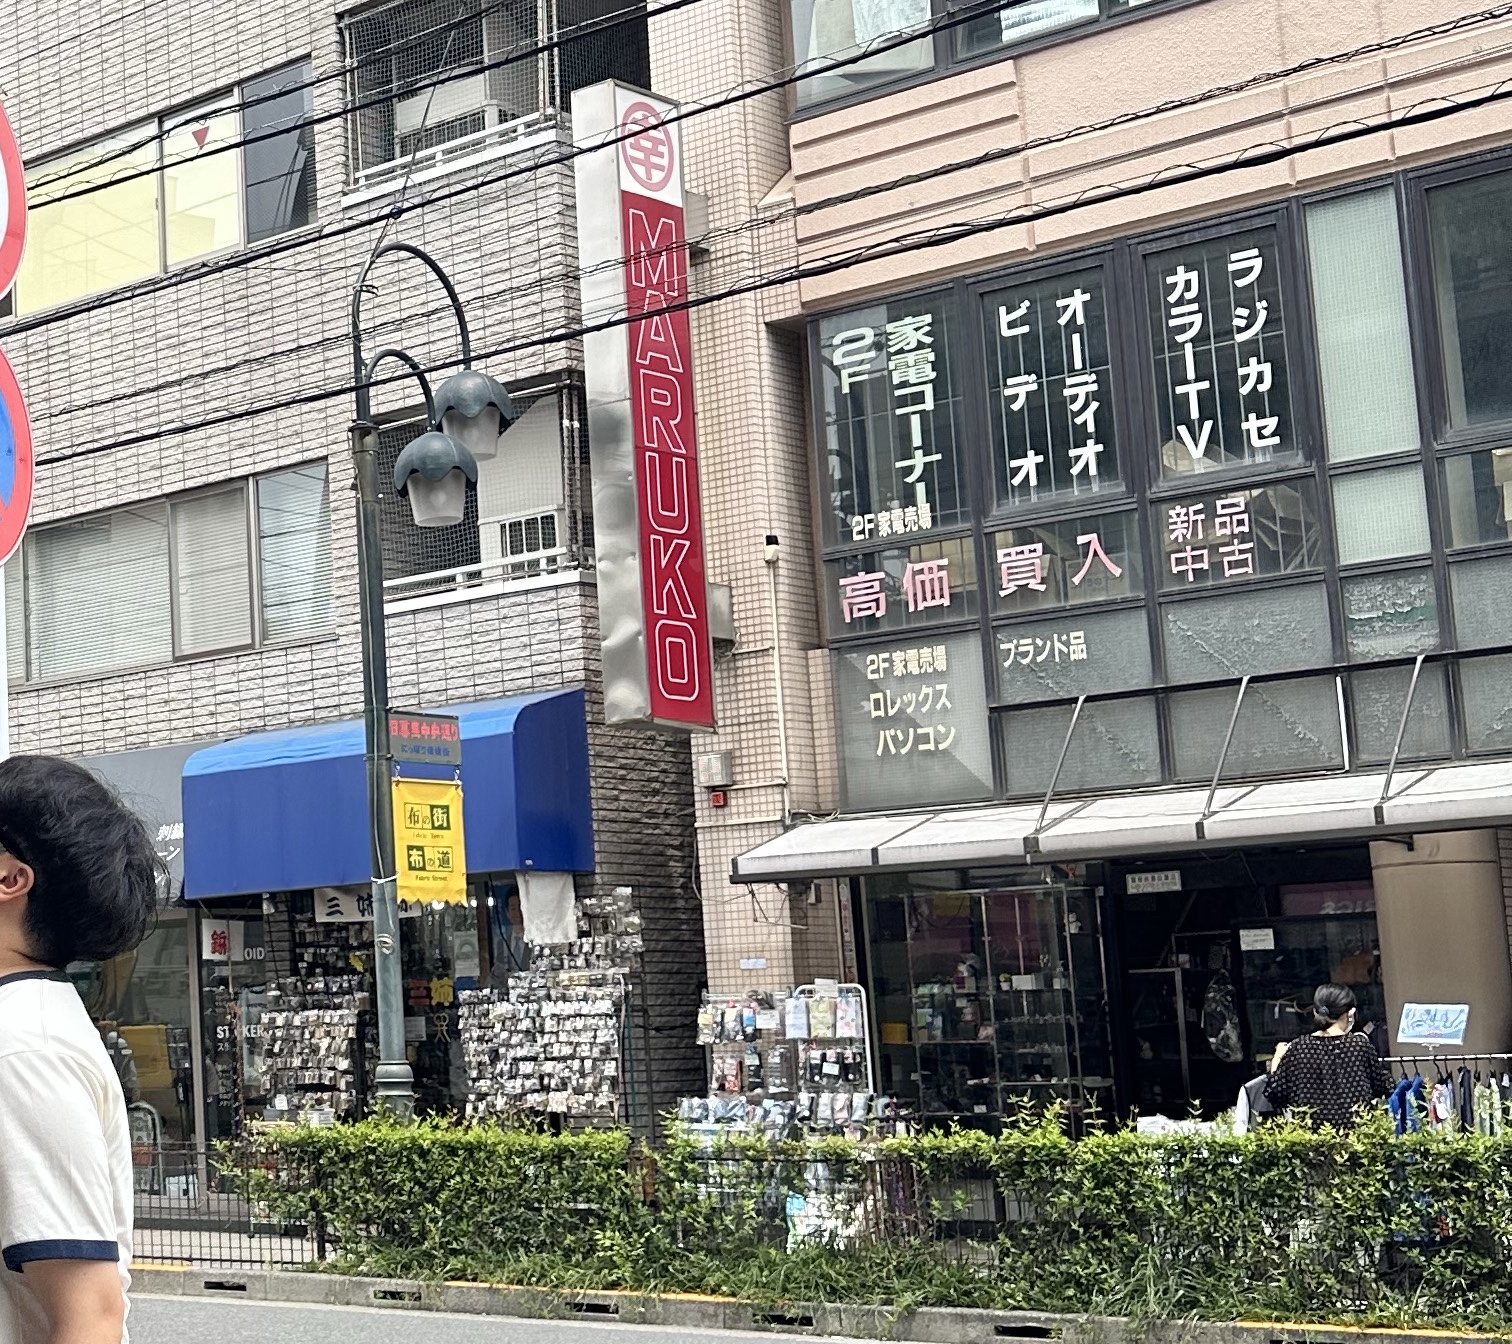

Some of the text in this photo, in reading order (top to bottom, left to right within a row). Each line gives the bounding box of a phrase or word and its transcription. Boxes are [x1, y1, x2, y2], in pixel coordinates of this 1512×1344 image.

[832, 326, 876, 395] 2F
[1165, 264, 1214, 459] カラーTV
[1227, 247, 1281, 448] ラジカセ
[885, 313, 943, 505] 家電コーナー
[998, 299, 1045, 487] ビデオ
[1055, 288, 1105, 477] オーディオ
[628, 208, 699, 701] MARUKO
[1168, 496, 1250, 543] 新品
[1170, 538, 1254, 582] 中古
[999, 630, 1088, 668] ブランド品
[869, 683, 952, 719] ロレックス
[407, 806, 449, 828] 布の街
[408, 849, 452, 869] 布の道
